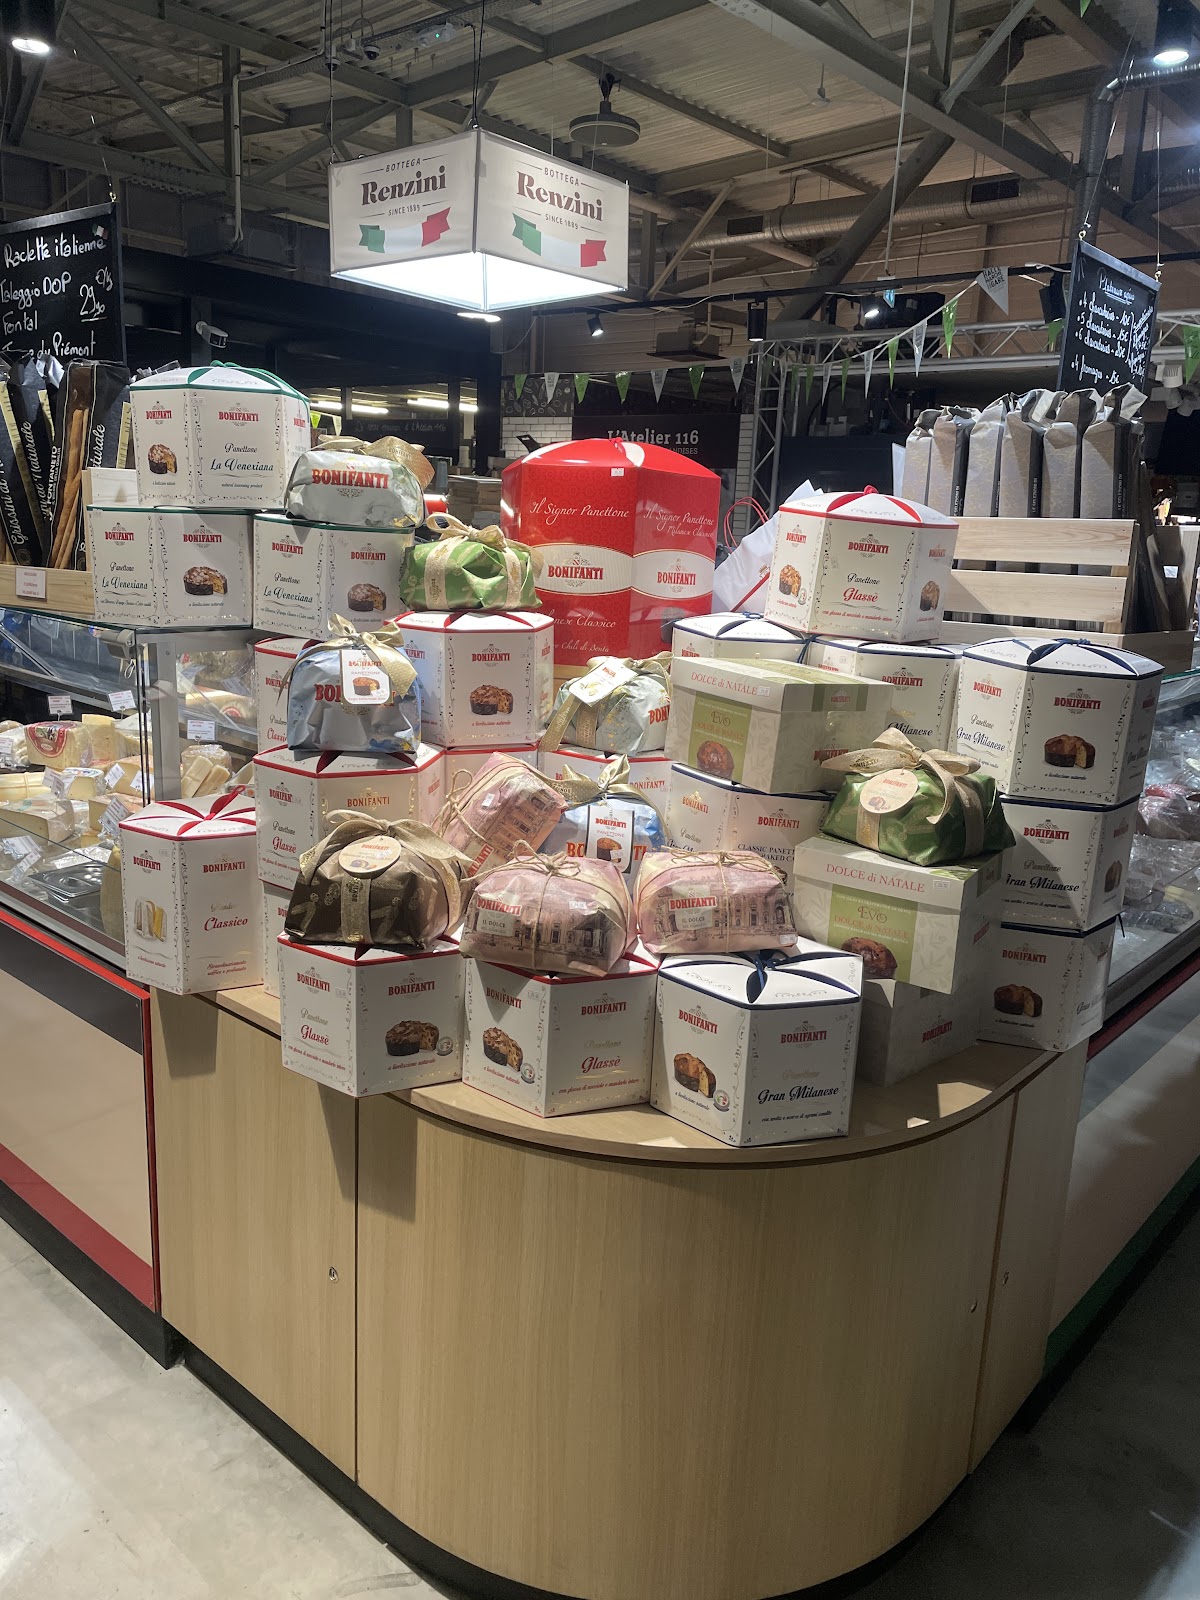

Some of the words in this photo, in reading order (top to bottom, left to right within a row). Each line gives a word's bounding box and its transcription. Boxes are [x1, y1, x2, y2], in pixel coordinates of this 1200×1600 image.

[385, 157, 421, 173] BOTTEGA
[544, 166, 580, 187] BOTTEGA
[361, 165, 447, 206] Renzini
[516, 170, 603, 222] Renzini
[388, 205, 406, 217] SINCE
[544, 213, 563, 226] SINCE
[4, 235, 52, 268] Raclette
[54, 232, 107, 258] italienne
[0, 278, 41, 310] Taleggio
[42, 271, 72, 296] DOP
[2, 310, 38, 336] Fontal
[52, 331, 97, 356] Piémont
[146, 410, 172, 420] BONIFANTI
[218, 411, 259, 422] BONIFANTI
[675, 429, 699, 446] 116
[20, 420, 42, 482] Naturale
[224, 442, 258, 454] Panettone
[210, 459, 221, 471] La
[224, 458, 274, 472] Venexiana
[47, 445, 58, 505] FONTANETO
[311, 468, 389, 489] BONIFANTI
[546, 503, 578, 525] Signor
[580, 505, 630, 518] Panettone
[655, 512, 680, 531] Signor
[682, 513, 715, 526] Panettone
[104, 531, 134, 541] BONIFANTI
[183, 534, 222, 543] BONIFANTI
[785, 532, 807, 544] BONIFANTI
[271, 542, 304, 555] BONIFANTI
[848, 541, 889, 554] BONIFANTI
[350, 551, 386, 561] BONIFANTI
[110, 561, 135, 572] Panettone
[547, 564, 604, 580] BONIFANTI
[101, 576, 110, 588] La
[274, 572, 300, 585] Panettone
[656, 571, 696, 586] BONIFANTI
[847, 572, 880, 585] Panettone
[263, 585, 273, 597] La
[576, 611, 616, 628] Classico
[580, 642, 587, 651] di
[471, 652, 510, 663] BONIFANTI
[690, 671, 717, 687] DOLCE
[717, 678, 725, 687] di
[726, 680, 758, 696] NATALE
[882, 675, 923, 687] BONIFANTI
[973, 681, 1002, 697] BONIFANTI
[1054, 696, 1101, 710] BONIFANTI
[886, 721, 933, 736] Milanese
[970, 714, 994, 729] Panettone
[956, 726, 972, 741] Gran
[973, 731, 1006, 752] Milanese
[347, 796, 390, 807] BONIFANTI
[682, 797, 709, 814] BONIFANTI
[272, 820, 296, 836] Panettone
[595, 818, 627, 829] BONIFANTI
[757, 816, 800, 829] BONIFANTI
[597, 829, 625, 838] PANETTONE
[1023, 827, 1070, 841] BONIFANTI
[737, 843, 767, 852] CLASSIC
[133, 856, 161, 871] BONIFANTI
[202, 860, 246, 874] BONIFANTI
[1023, 860, 1062, 873] Panettone
[826, 863, 866, 882] DOLCE
[867, 872, 877, 882] di
[879, 874, 925, 893] NATALE
[1029, 876, 1080, 892] Milanese
[477, 898, 522, 915] BONIFANTI
[670, 896, 717, 909] BONIFANTI
[204, 916, 248, 932] Classico
[488, 920, 506, 929] DOLCE
[1002, 949, 1047, 964] BONIFANTI
[296, 972, 331, 992] BONIFANTI
[388, 980, 435, 996] BONIFANTI
[486, 986, 522, 1010] BONIFANTI
[581, 1001, 627, 1016] BONIFANTI
[300, 1007, 328, 1026] Panettone
[678, 1009, 718, 1034] BONIFANTI
[780, 1030, 827, 1044] BONIFANTI
[922, 1020, 953, 1044] BONIFANTI
[757, 1088, 786, 1105] Gran
[789, 1085, 839, 1101] Milanese
